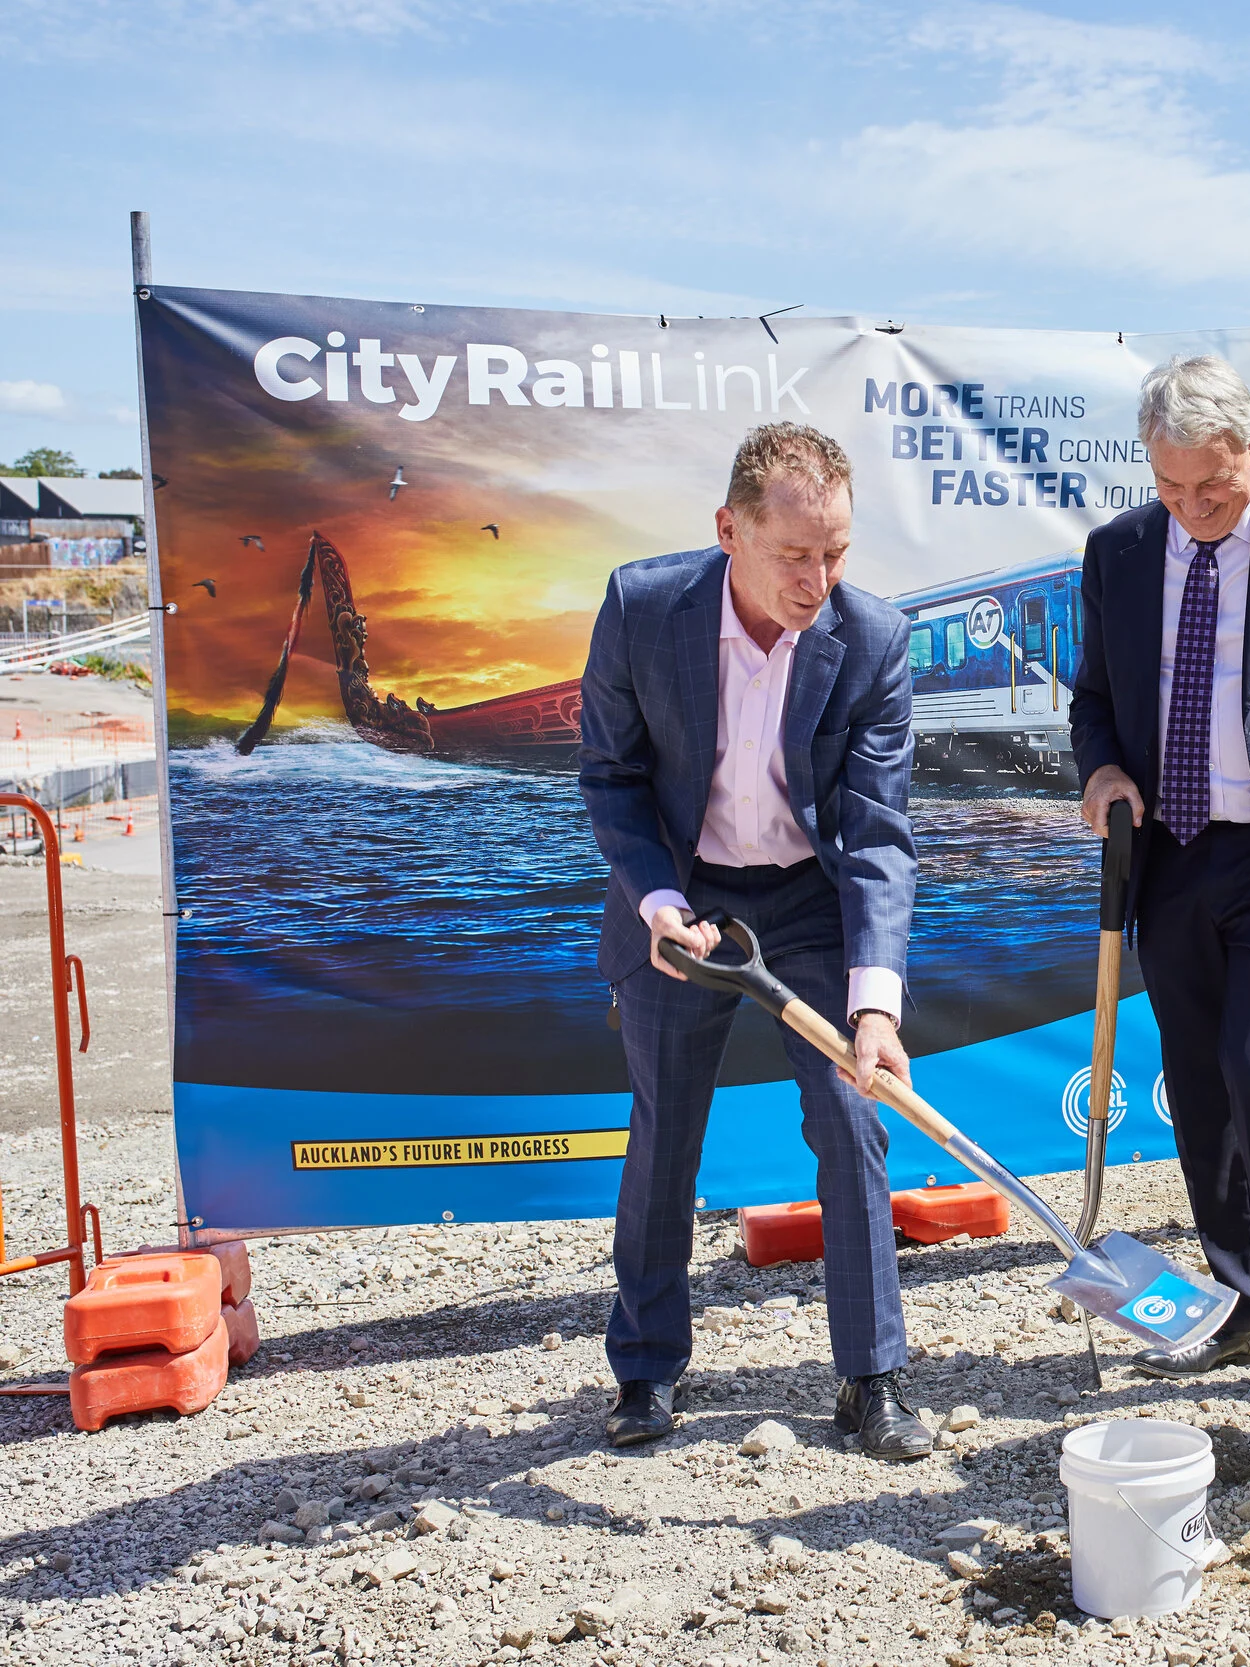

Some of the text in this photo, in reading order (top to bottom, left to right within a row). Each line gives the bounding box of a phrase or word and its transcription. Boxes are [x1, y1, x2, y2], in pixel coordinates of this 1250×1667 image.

[864, 378, 1085, 420] MORE TRAINS
[892, 424, 1049, 464] BETTER
[932, 469, 1087, 509] FASTER
[300, 1138, 570, 1164] AUCKLAND'S FUTURE IN PROGRESS
